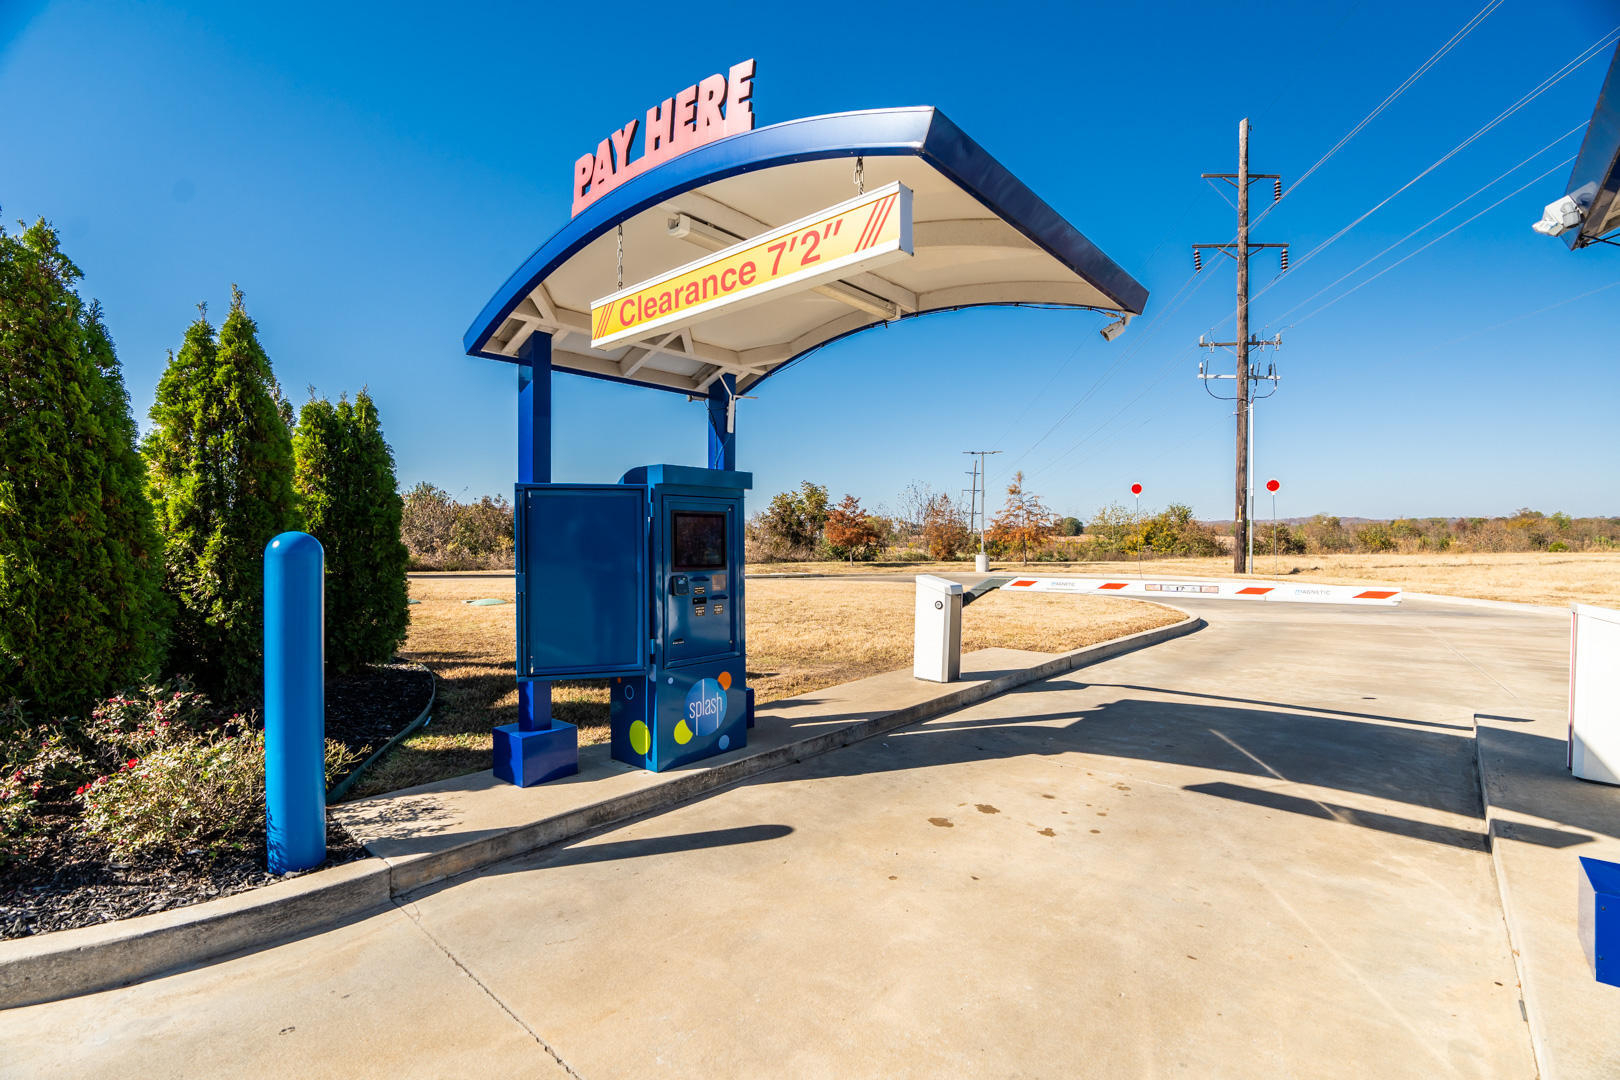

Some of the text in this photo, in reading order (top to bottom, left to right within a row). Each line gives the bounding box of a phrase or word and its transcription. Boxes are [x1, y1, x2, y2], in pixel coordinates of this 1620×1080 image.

[573, 58, 756, 212] PAY HERE
[618, 258, 757, 327] Clearance
[689, 679, 723, 736] splash
